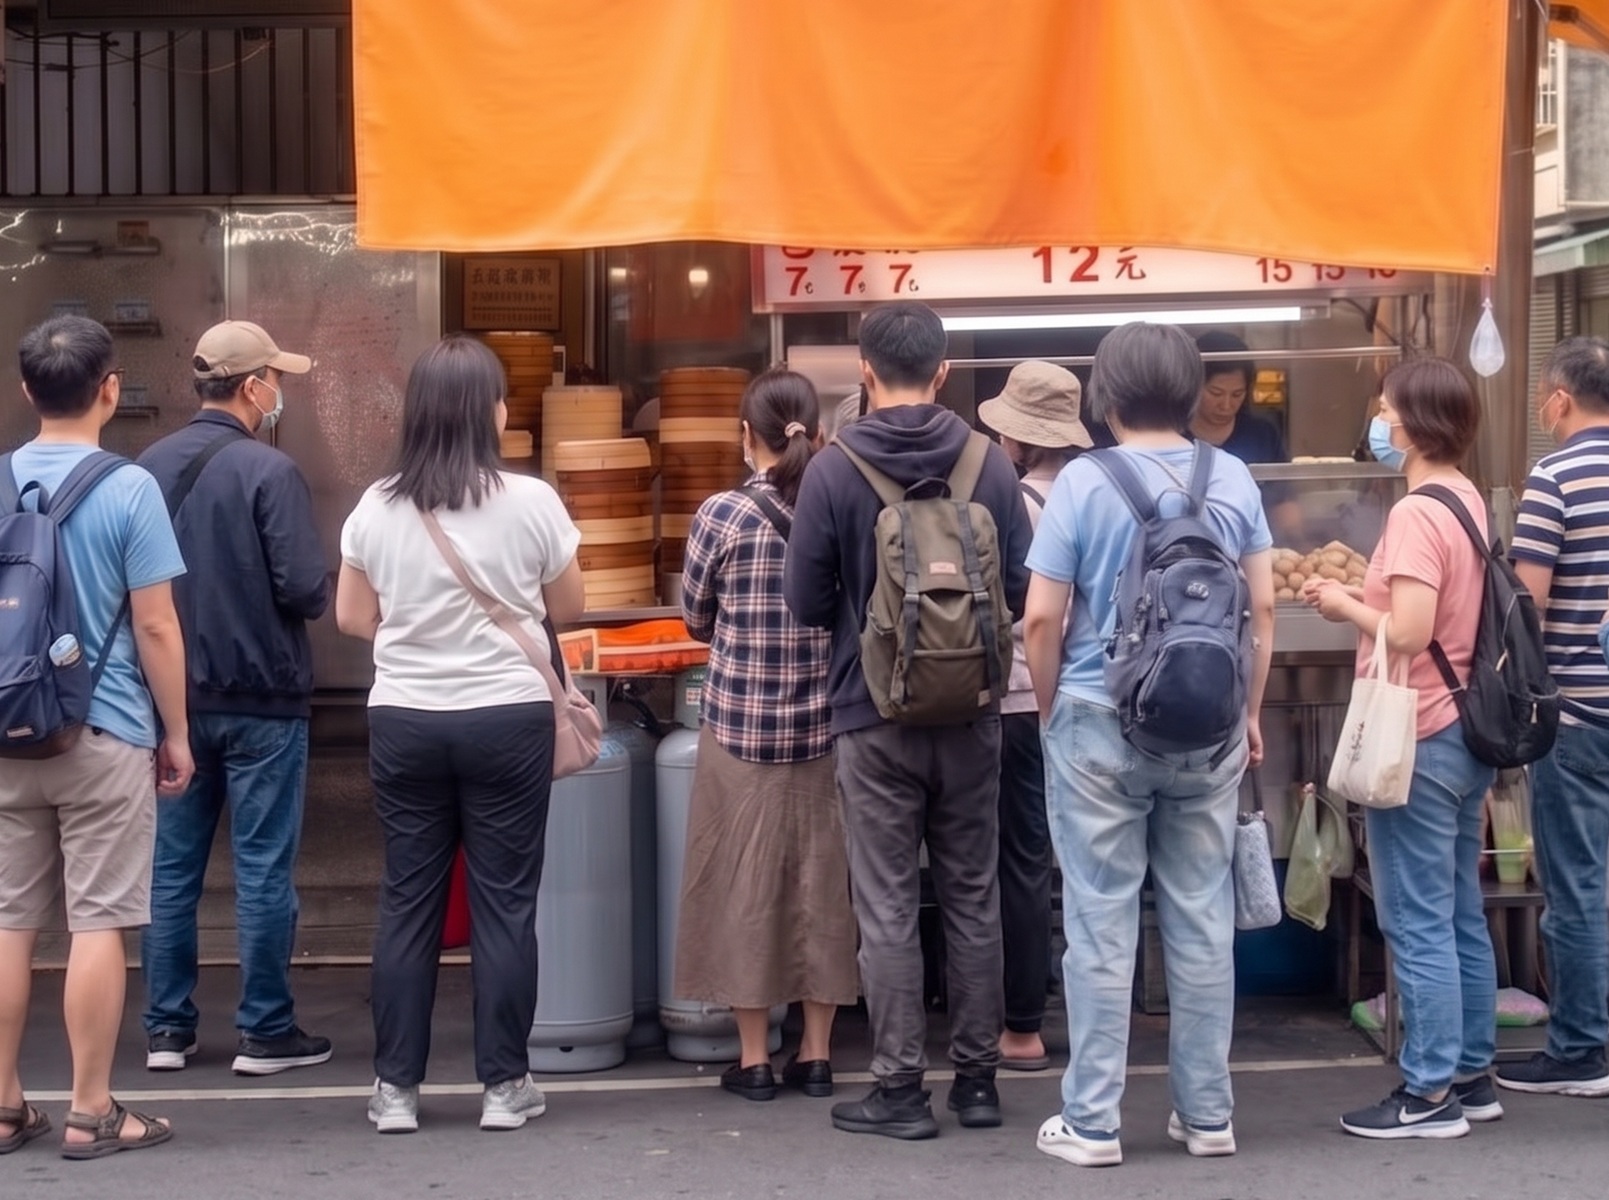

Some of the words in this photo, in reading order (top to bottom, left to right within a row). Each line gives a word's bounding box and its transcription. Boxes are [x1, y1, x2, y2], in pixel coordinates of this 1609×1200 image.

[785, 266, 808, 296] 7
[840, 265, 863, 294] 7
[889, 264, 913, 293] 7
[1256, 257, 1292, 283] 15
